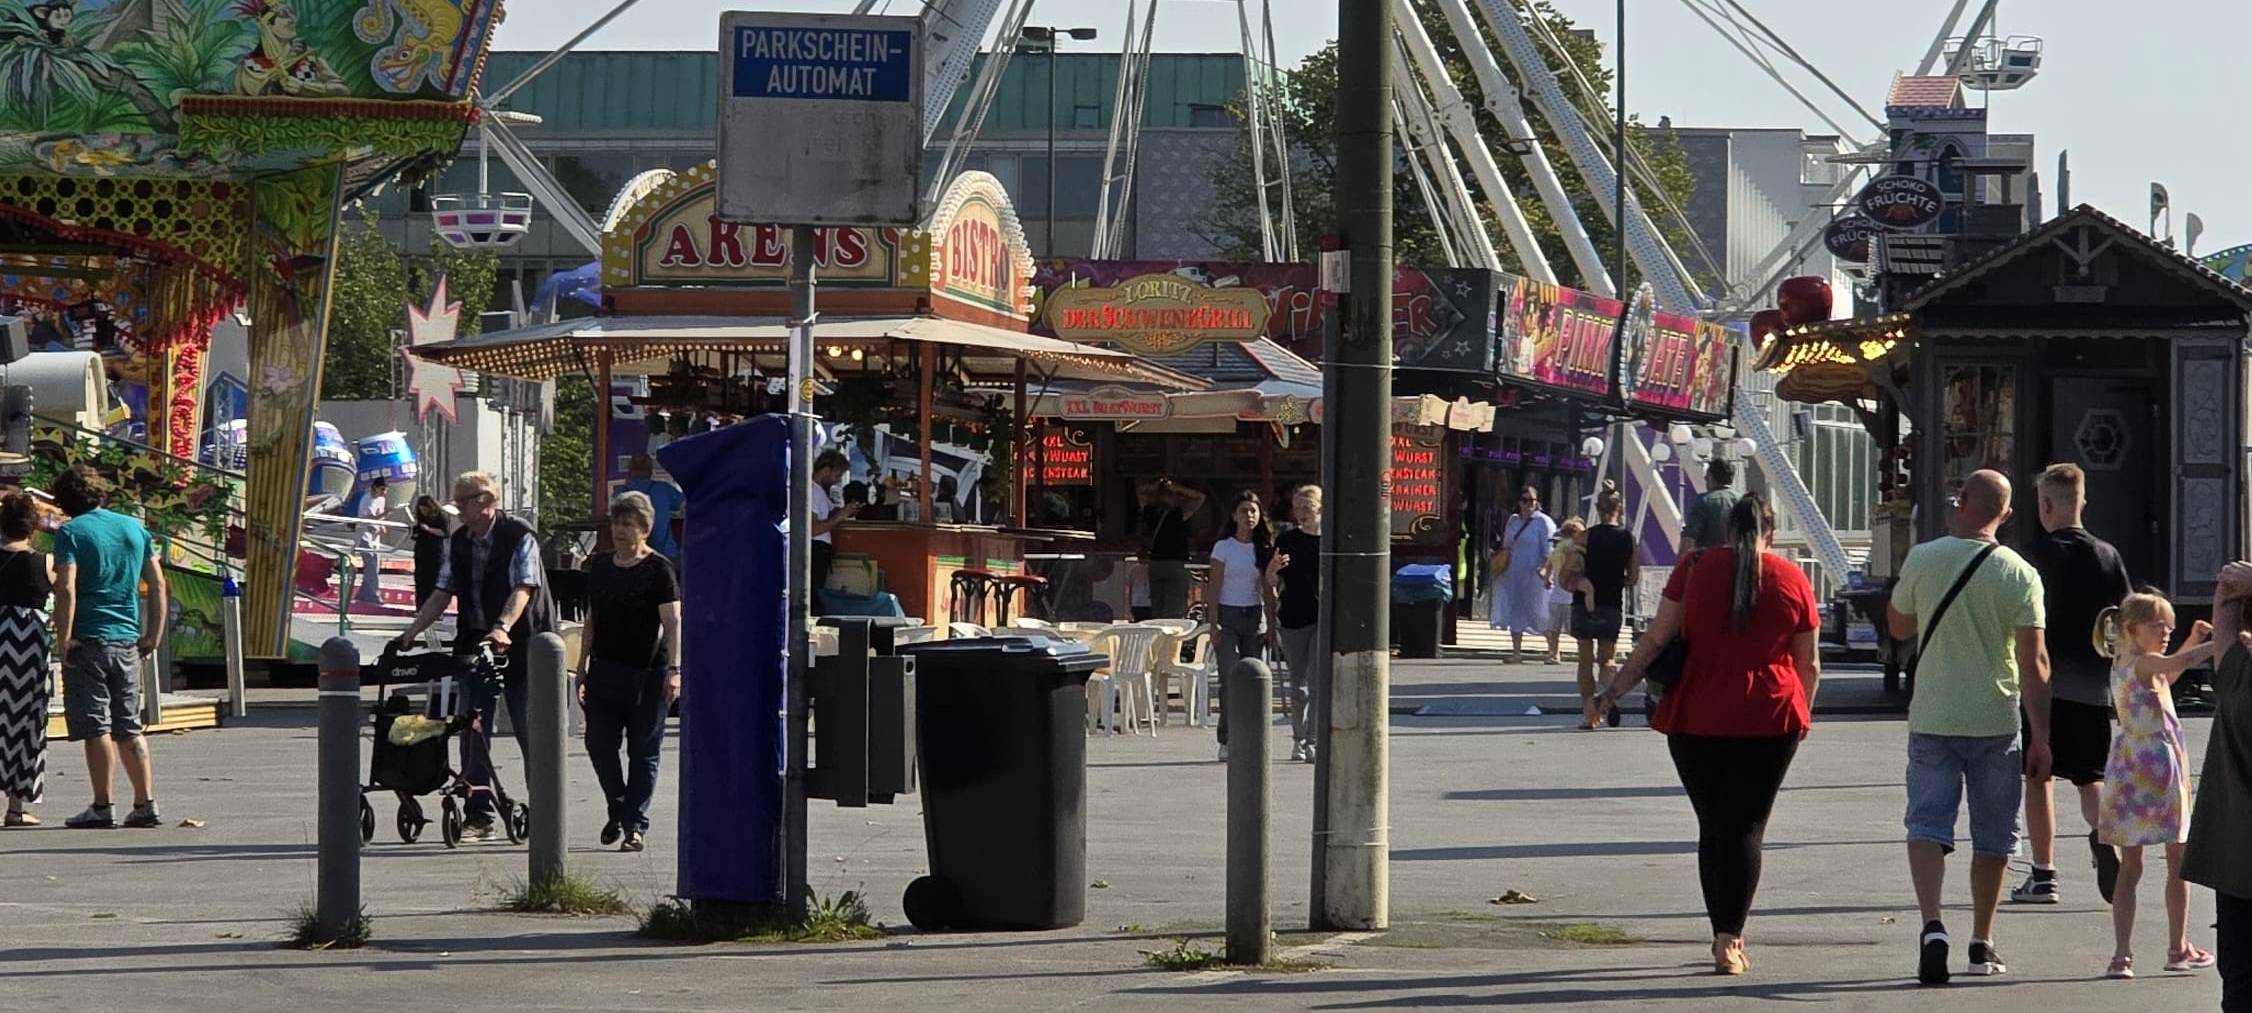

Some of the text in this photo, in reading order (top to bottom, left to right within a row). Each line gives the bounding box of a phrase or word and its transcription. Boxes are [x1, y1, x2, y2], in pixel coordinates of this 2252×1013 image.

[741, 29, 903, 62] PARKSCHEIN-
[767, 64, 877, 96] AUTOMAT
[1876, 180, 1927, 192] SCHOKO
[951, 218, 1010, 291] BISTRO
[1554, 308, 1616, 378] PINK
